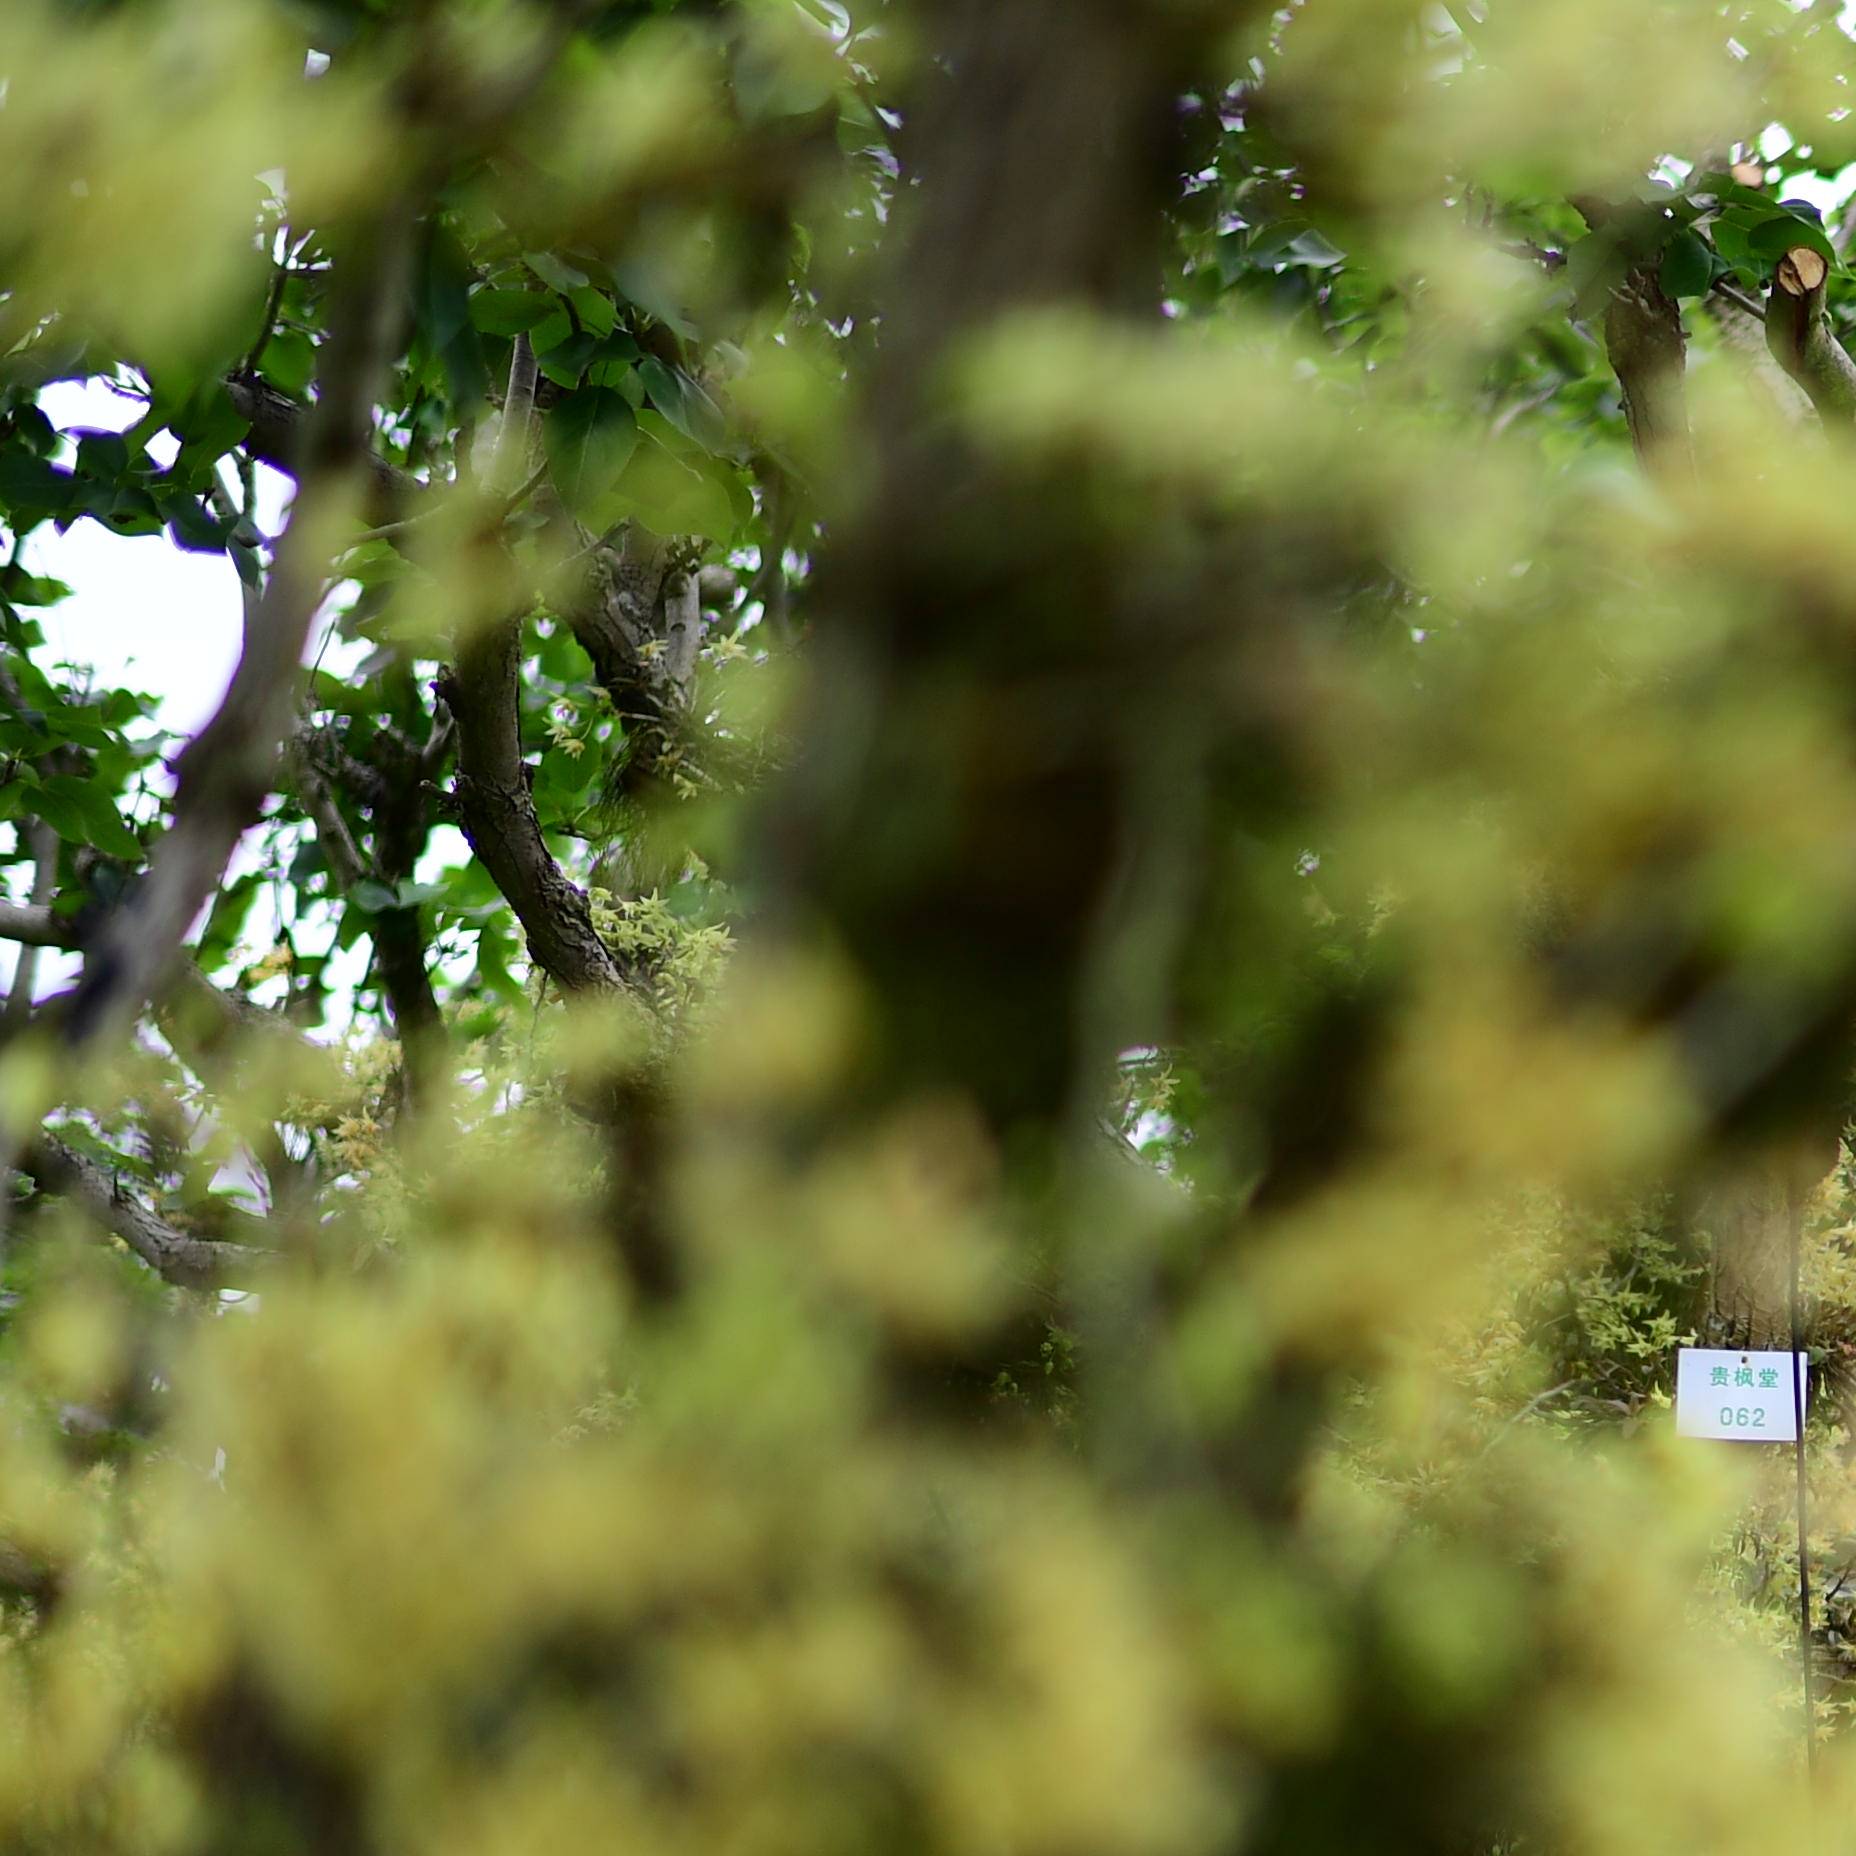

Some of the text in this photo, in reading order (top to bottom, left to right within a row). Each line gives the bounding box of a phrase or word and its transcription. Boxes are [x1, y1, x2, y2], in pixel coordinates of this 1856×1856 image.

[1709, 1366, 1779, 1388] 贵枫堂
[1720, 1407, 1765, 1427] 062
